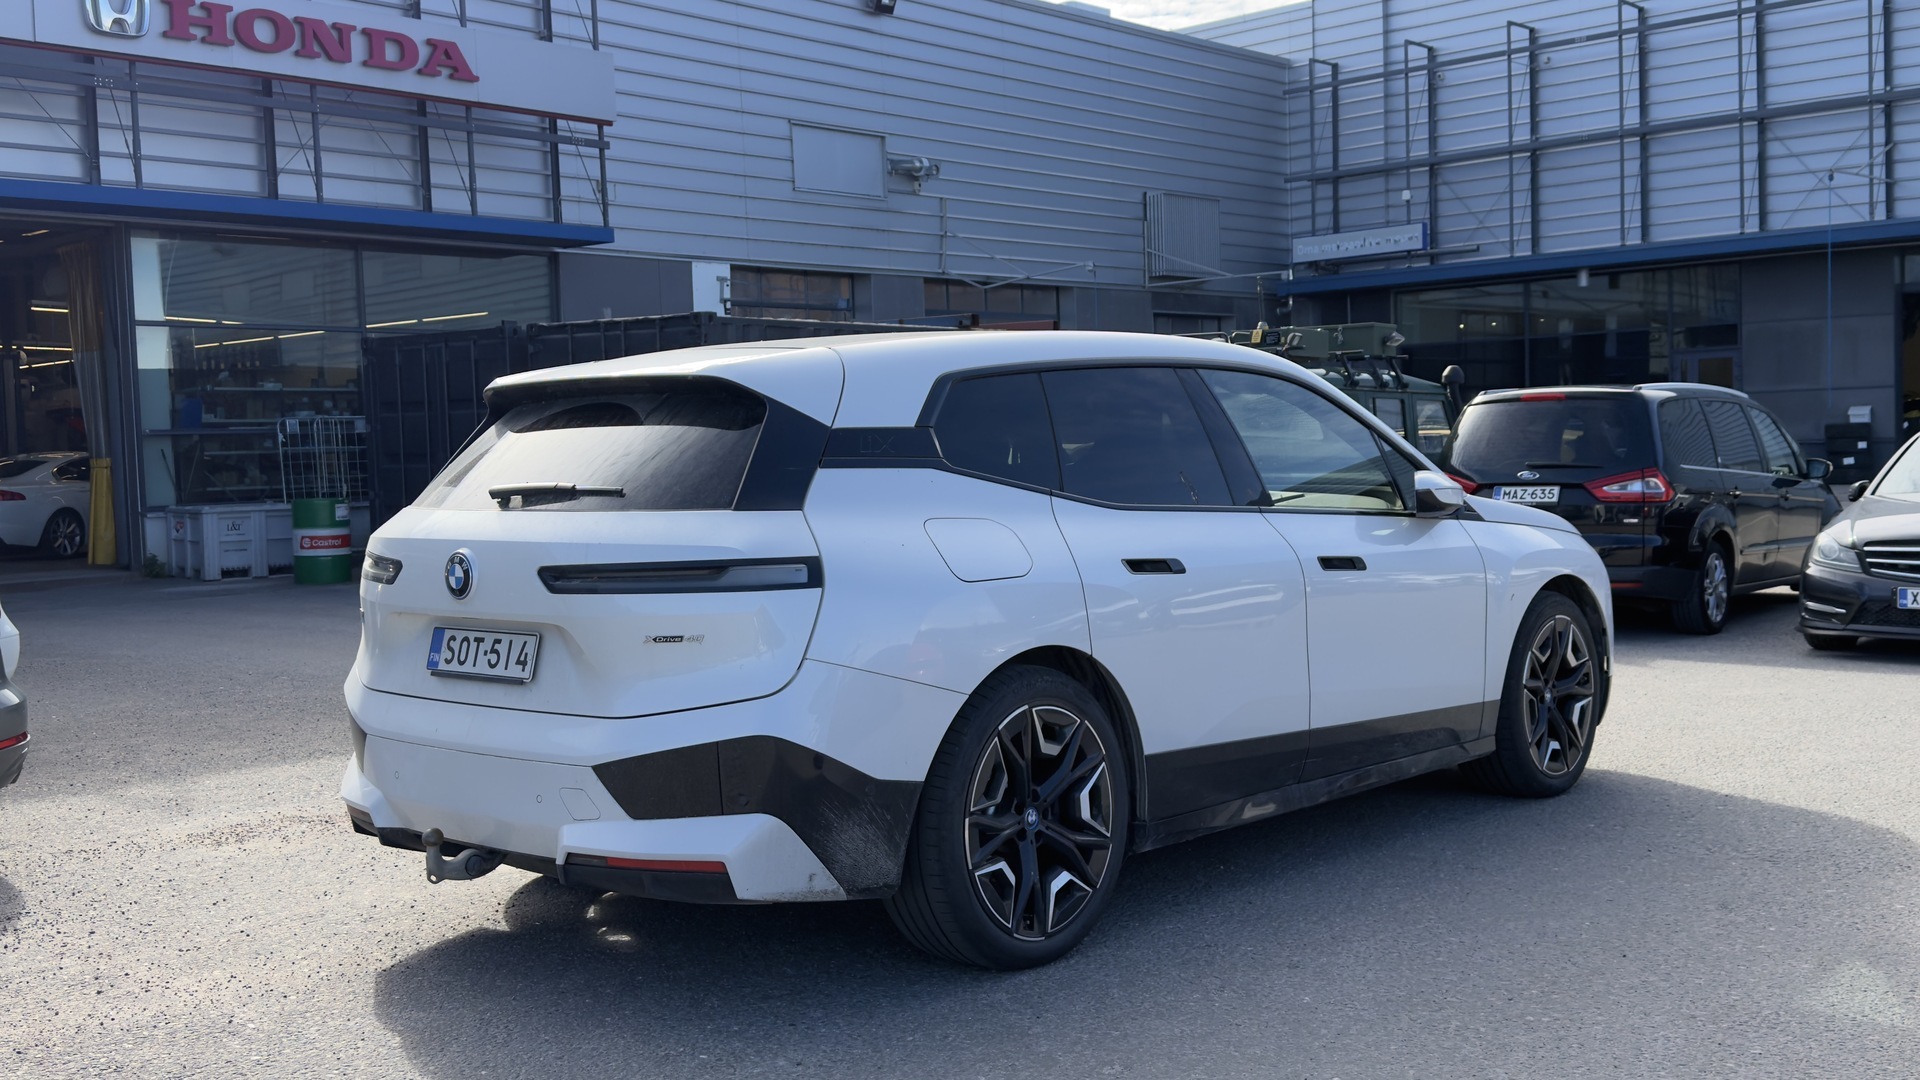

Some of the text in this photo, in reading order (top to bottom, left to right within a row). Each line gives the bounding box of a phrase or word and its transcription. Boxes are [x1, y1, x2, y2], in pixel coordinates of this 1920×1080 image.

[162, 0, 480, 83] HONDA
[1502, 488, 1556, 500] MAZ-635
[312, 538, 341, 547] Castrol
[429, 634, 529, 673] FIN SOT-514
